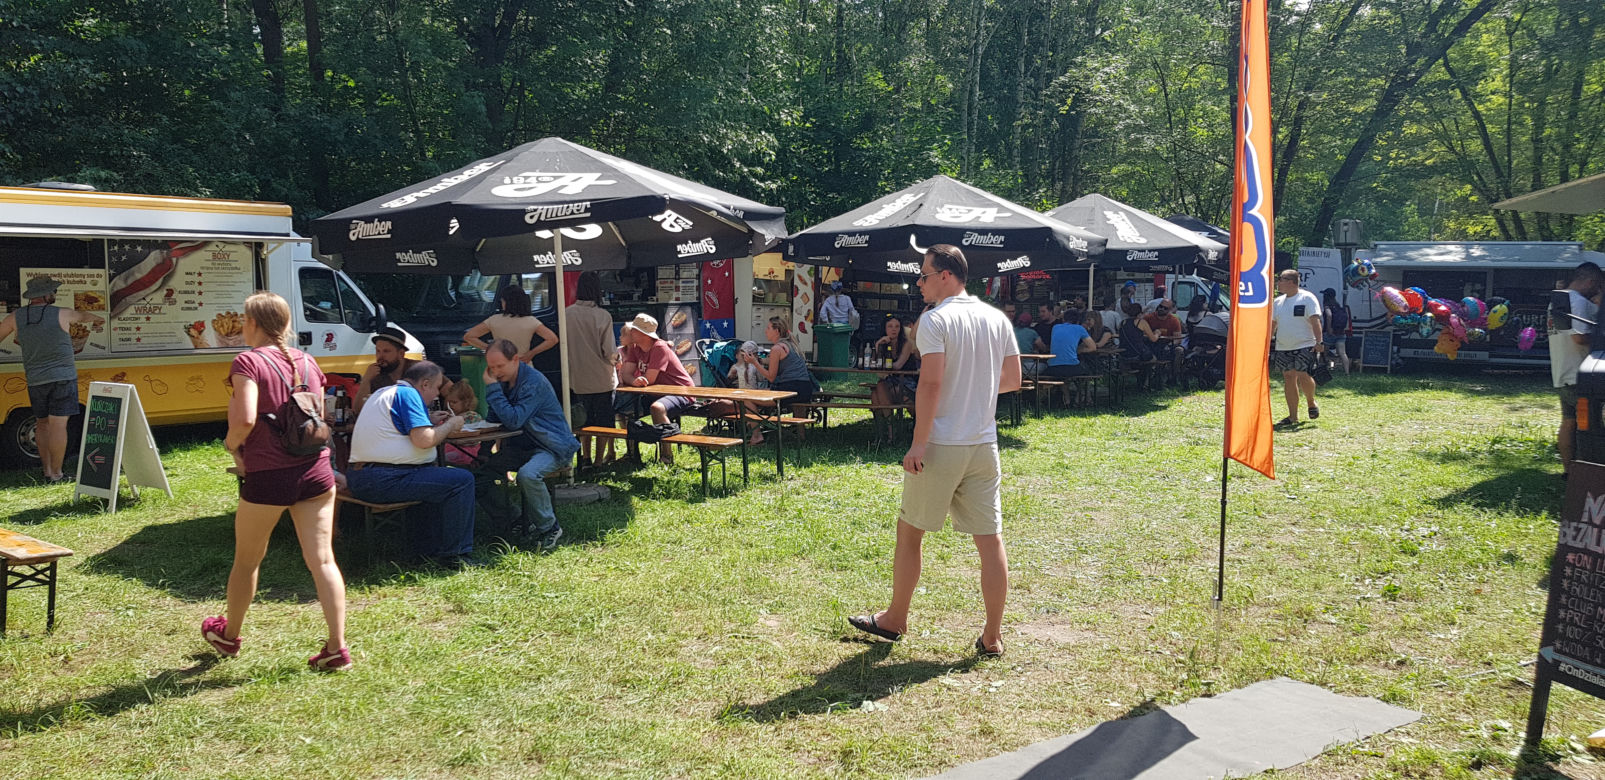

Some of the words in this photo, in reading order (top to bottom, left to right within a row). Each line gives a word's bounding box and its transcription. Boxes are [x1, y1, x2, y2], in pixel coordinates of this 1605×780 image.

[349, 218, 392, 241] Amber
[834, 233, 870, 248] Amber
[962, 231, 1005, 247] Amber
[212, 252, 231, 260] BOXY
[1126, 249, 1159, 261] Amber
[134, 305, 163, 314] WRAPY
[95, 416, 107, 431] PO
[1559, 520, 1605, 554] BEZAL
